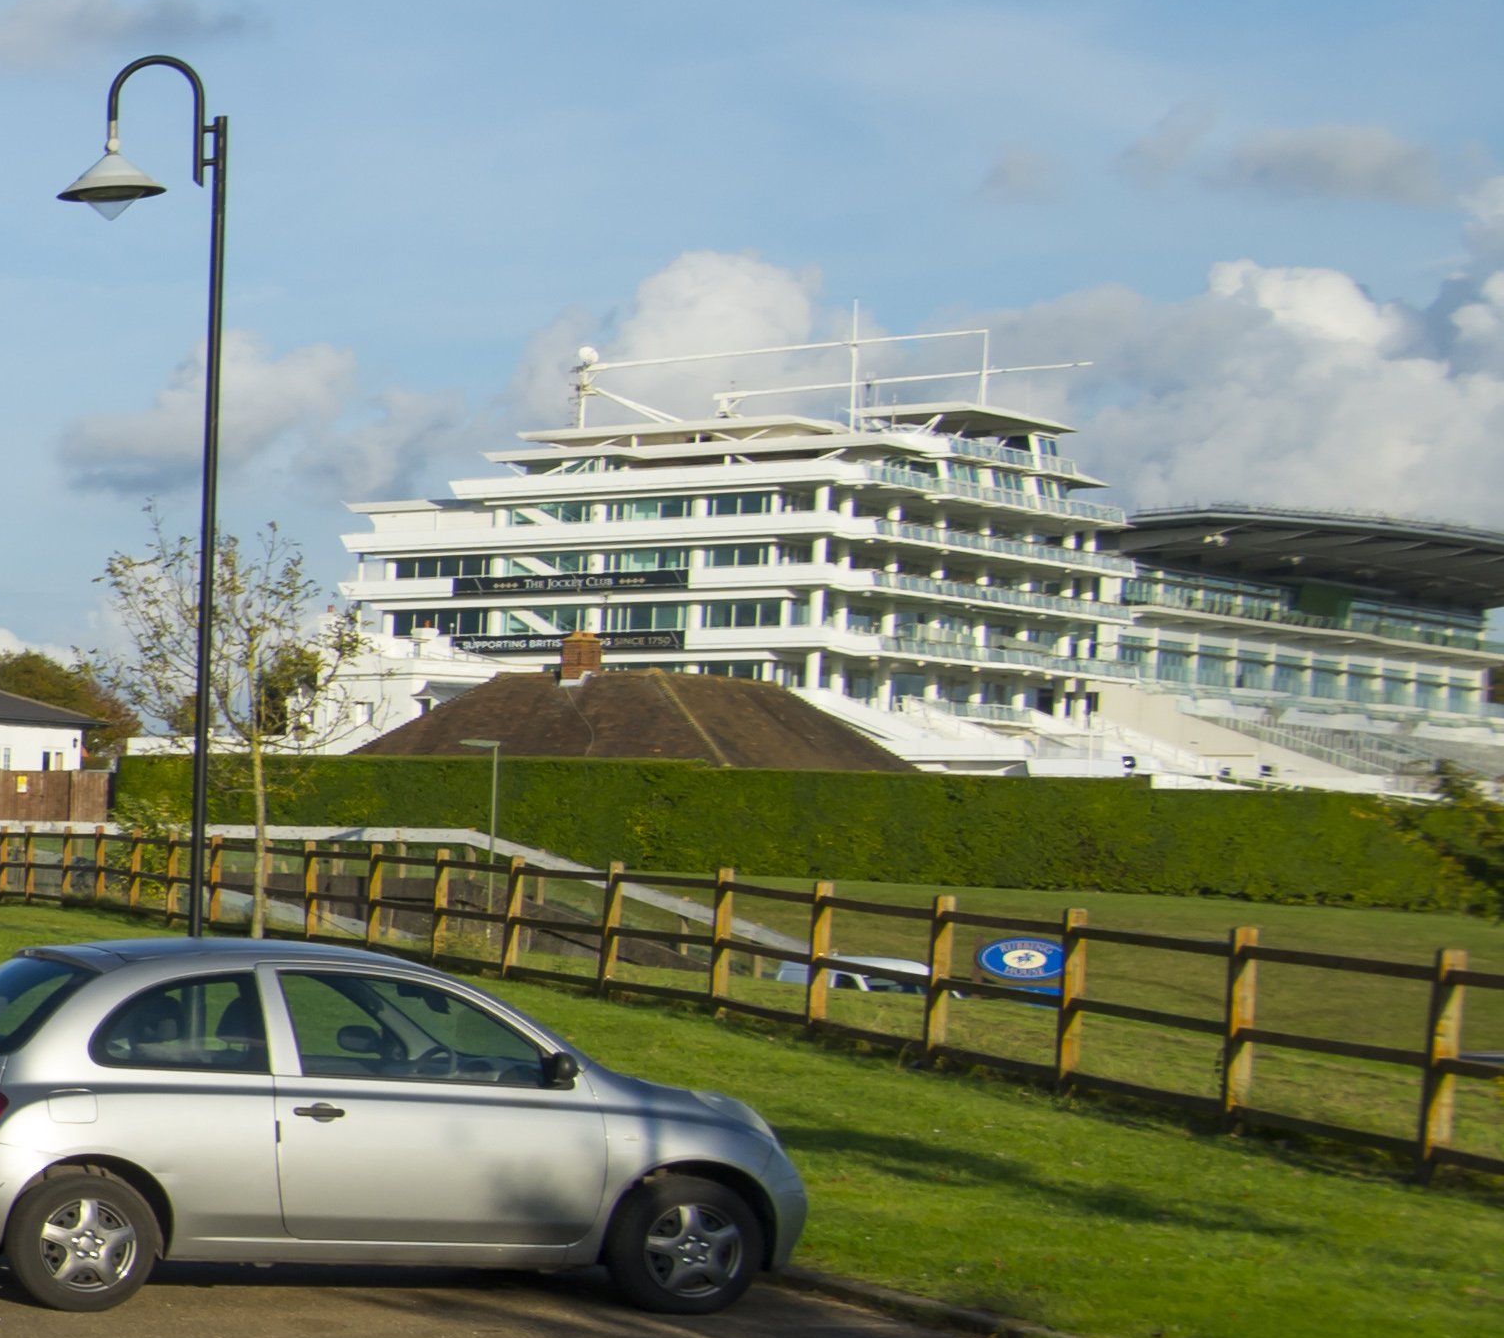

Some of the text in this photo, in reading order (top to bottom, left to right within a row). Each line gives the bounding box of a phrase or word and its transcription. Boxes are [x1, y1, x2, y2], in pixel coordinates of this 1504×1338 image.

[523, 576, 613, 590] THE JOCKEY CLUB
[462, 640, 527, 650] SUPPORTING
[529, 639, 562, 647] BRITIS
[614, 637, 645, 646] SINCE
